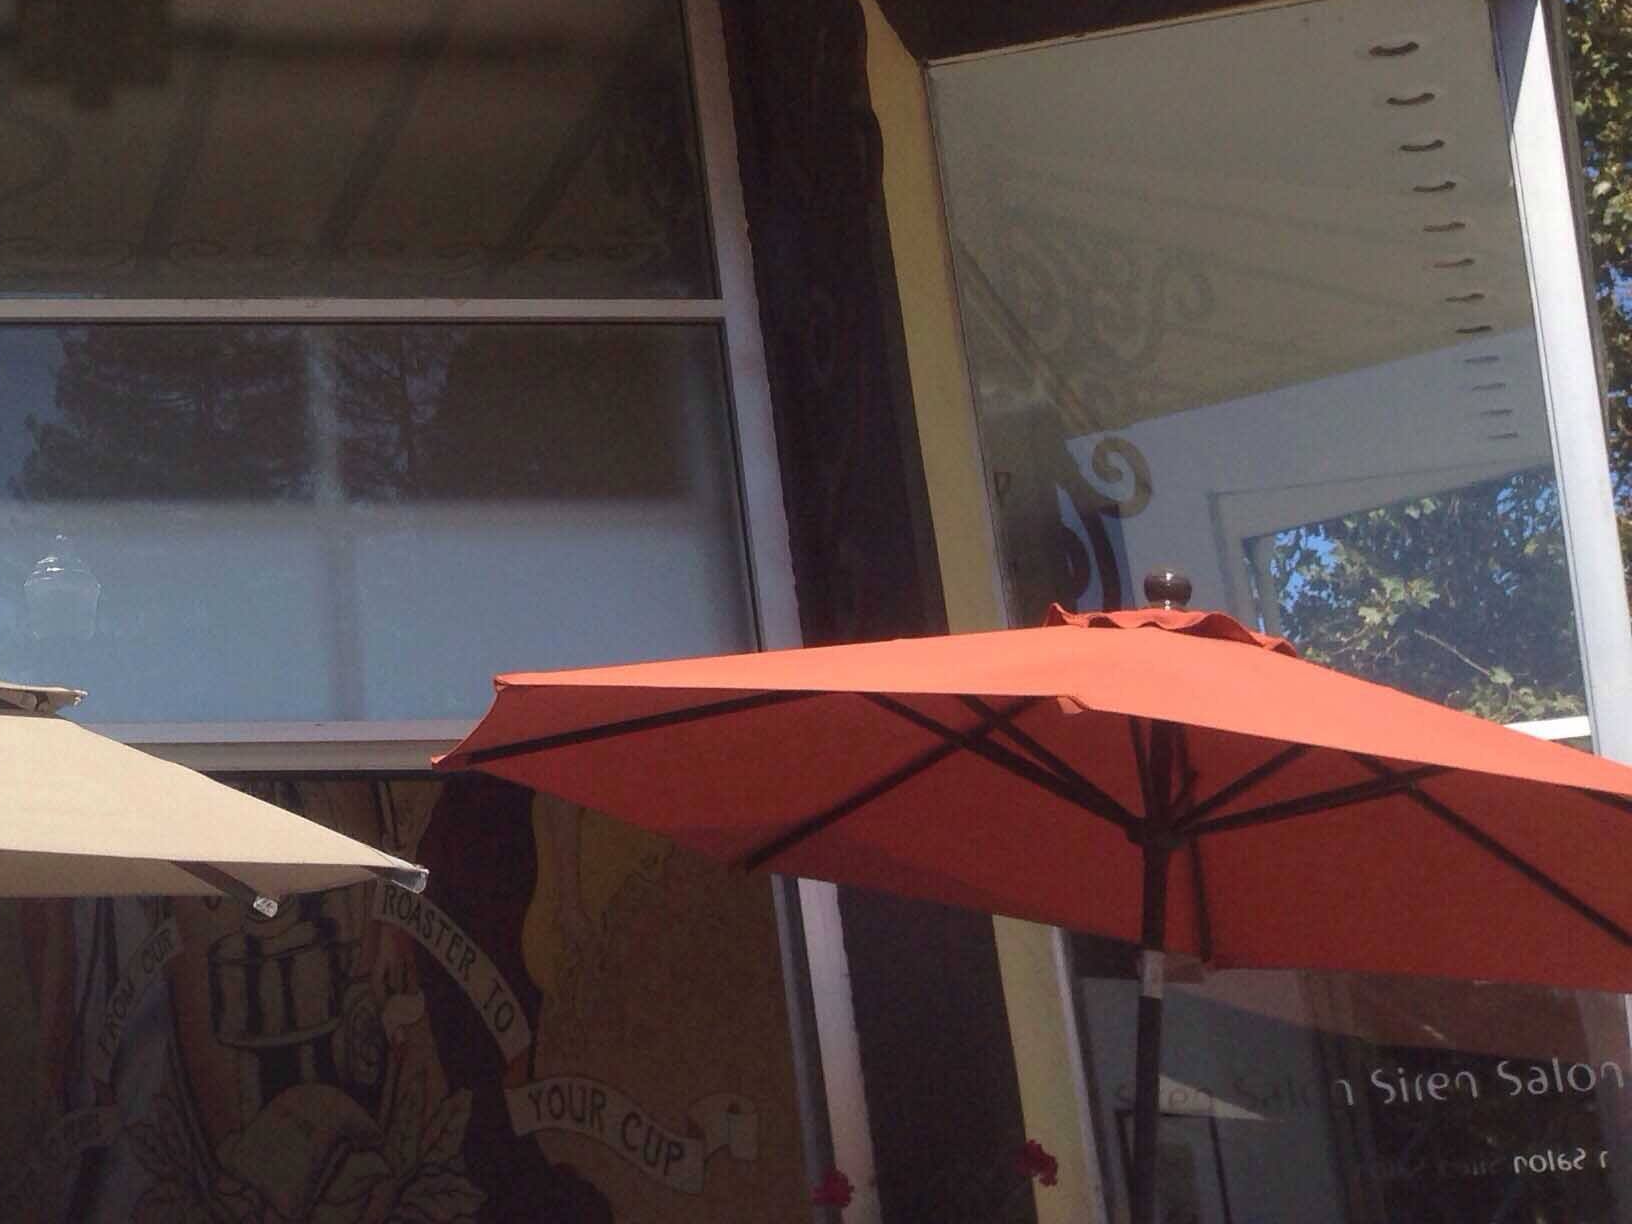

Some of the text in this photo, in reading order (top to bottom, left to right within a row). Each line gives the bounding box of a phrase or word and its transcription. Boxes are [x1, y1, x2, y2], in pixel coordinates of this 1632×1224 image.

[381, 883, 477, 972] ROASTER
[483, 977, 516, 1033] TO
[527, 1081, 608, 1134] YOUR
[620, 1110, 685, 1176] CUP
[1371, 1066, 1478, 1105] Siren
[1496, 1056, 1624, 1098] Salon
